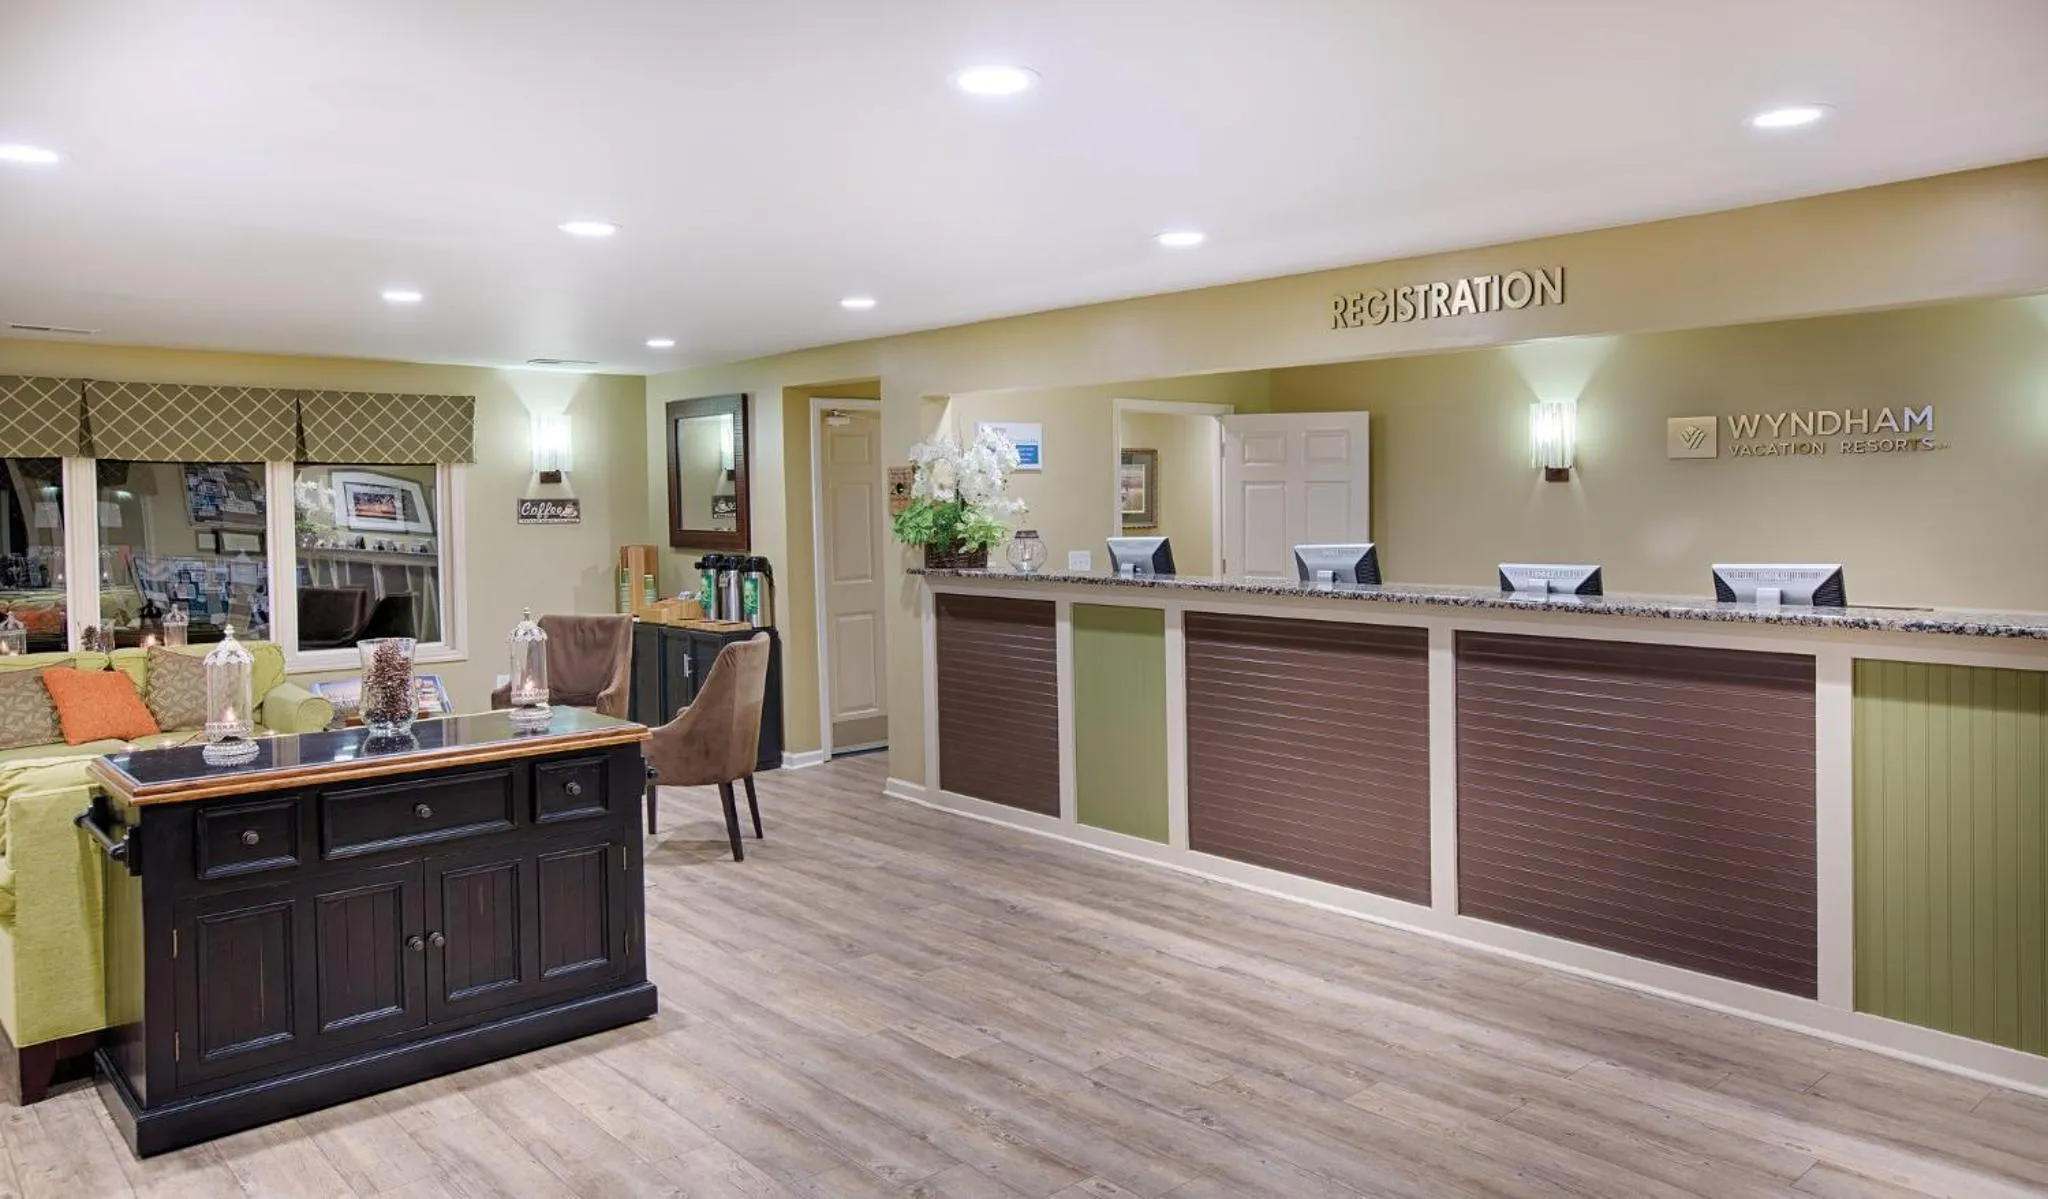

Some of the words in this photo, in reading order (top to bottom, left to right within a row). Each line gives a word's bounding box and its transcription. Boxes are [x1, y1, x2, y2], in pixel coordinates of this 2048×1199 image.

[1331, 266, 1565, 330] REGISTRATION
[1727, 404, 1934, 440] WYNDHAM
[1728, 442, 1825, 458] VACATION
[1840, 438, 1936, 455] RESORTS
[521, 502, 564, 519] Coffee
